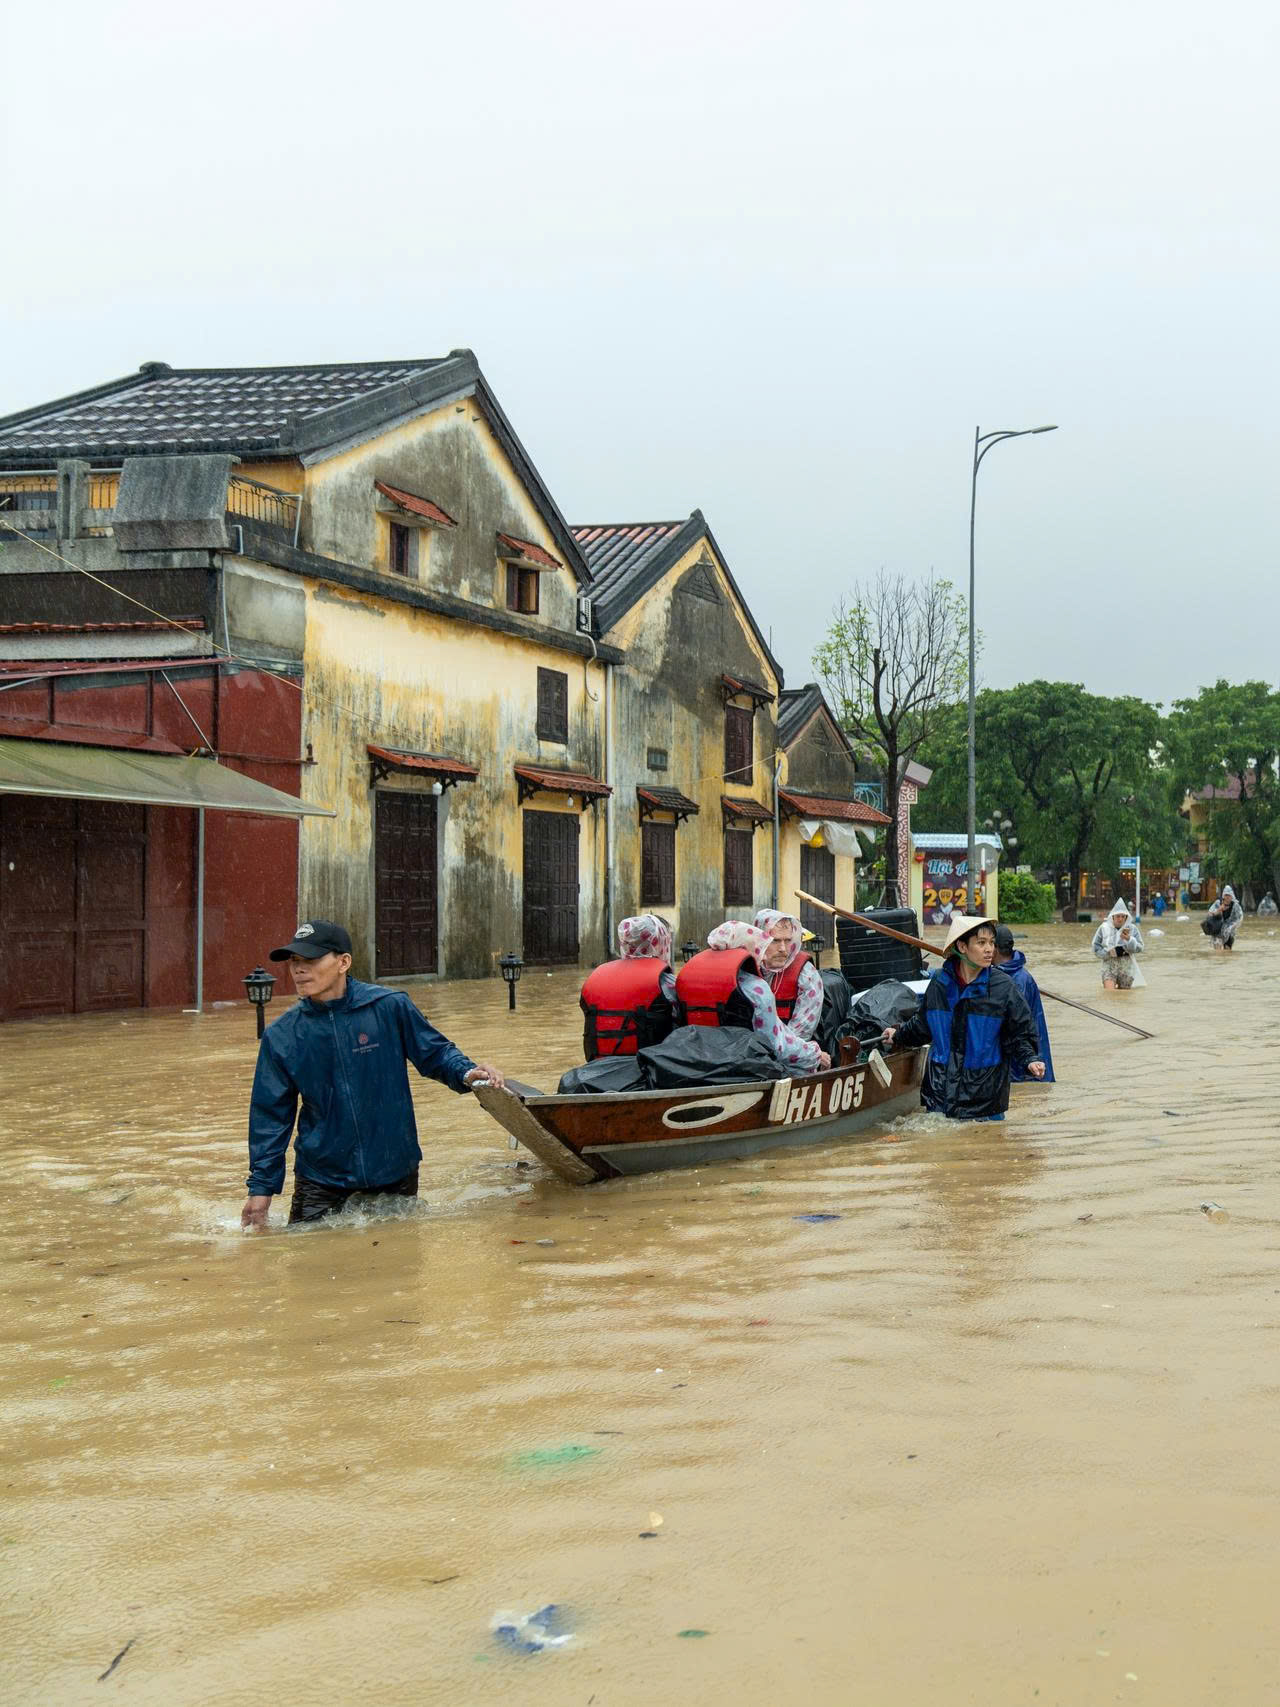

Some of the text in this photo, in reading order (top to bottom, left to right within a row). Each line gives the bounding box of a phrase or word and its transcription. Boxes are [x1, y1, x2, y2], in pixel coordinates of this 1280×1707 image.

[927, 858, 954, 877] Hội
[782, 1071, 866, 1126] HA 065
